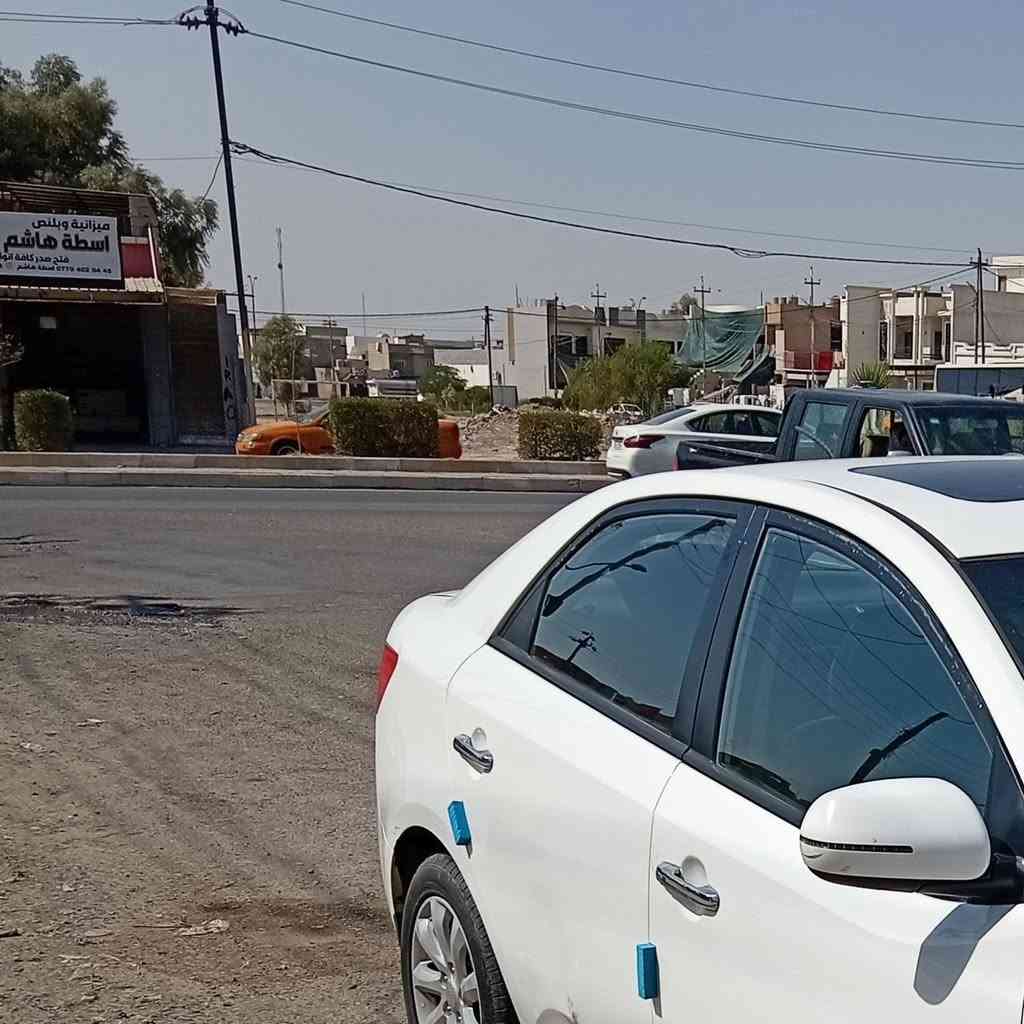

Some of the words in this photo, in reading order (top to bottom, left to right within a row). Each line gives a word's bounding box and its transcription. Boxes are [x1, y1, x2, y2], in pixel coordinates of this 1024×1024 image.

[31, 217, 69, 231] وبلنص
[71, 218, 110, 232] ميزانية
[3, 228, 58, 253] هاشم
[61, 233, 110, 252] اسطة
